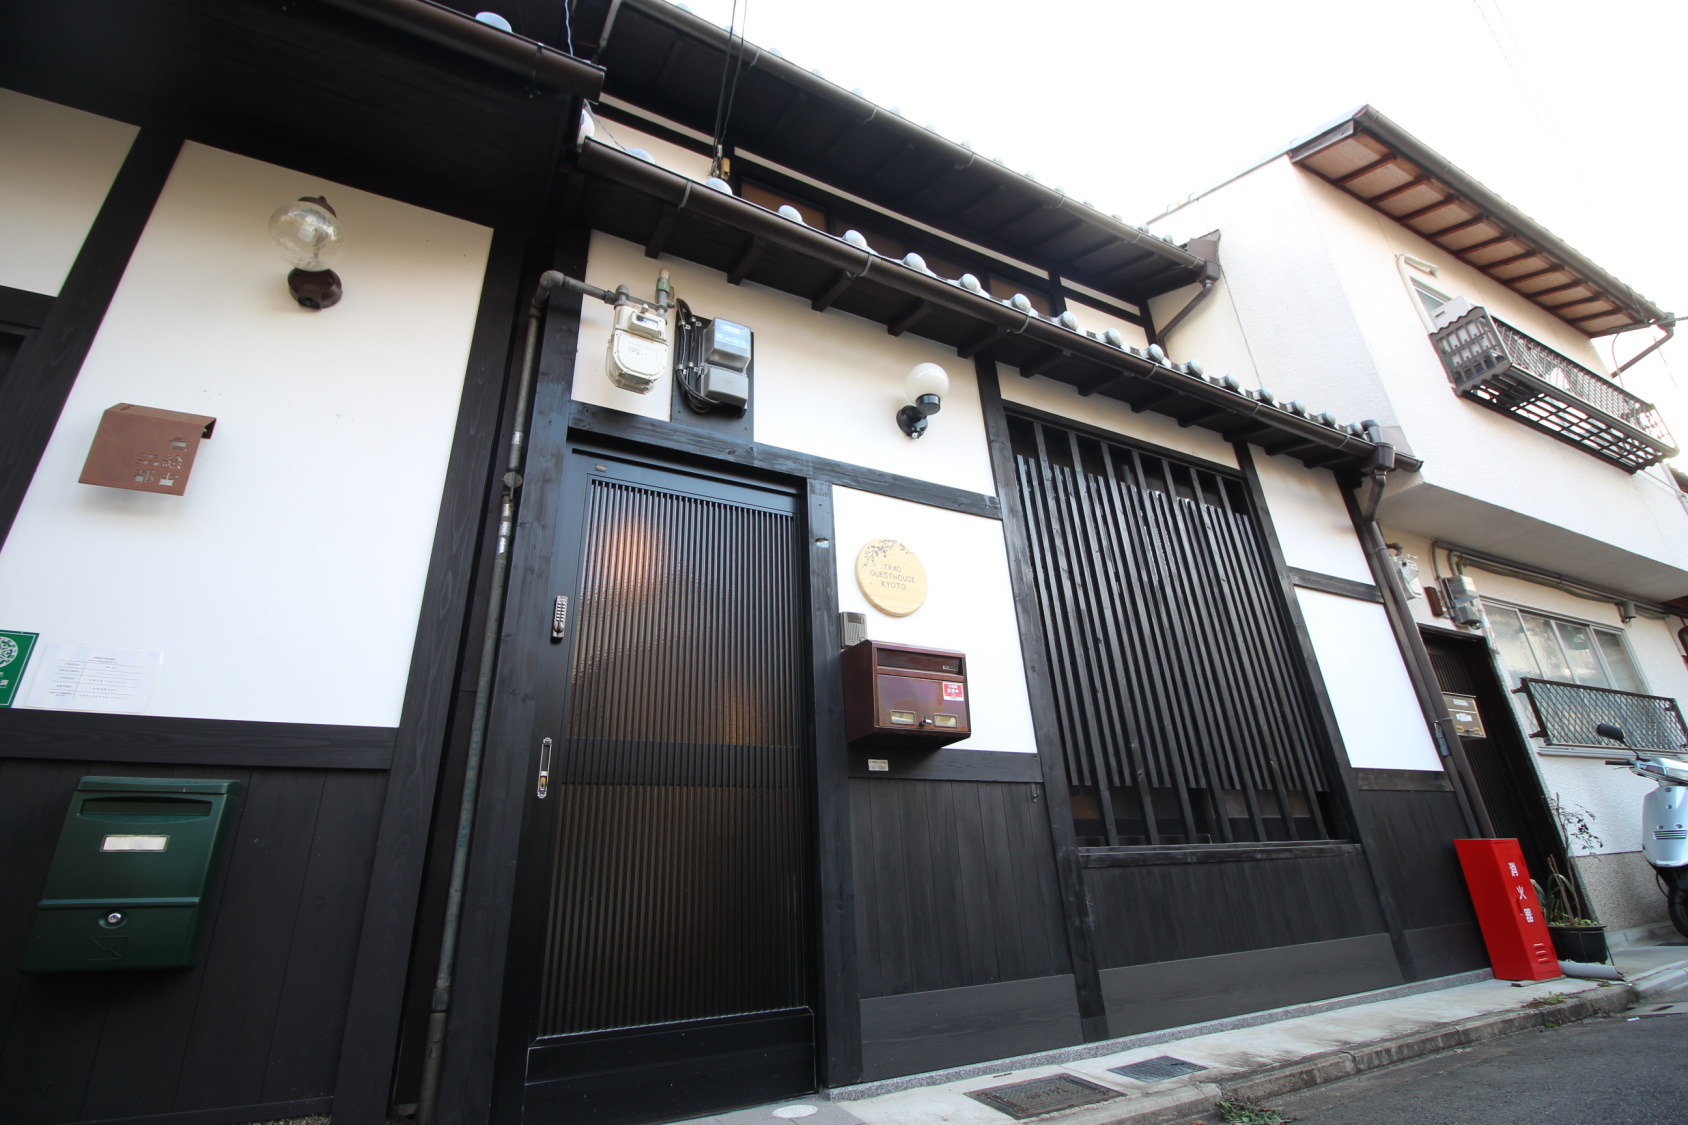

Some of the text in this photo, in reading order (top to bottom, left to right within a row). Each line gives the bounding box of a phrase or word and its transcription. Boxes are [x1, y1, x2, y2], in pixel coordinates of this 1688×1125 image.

[883, 563, 902, 573] TRAD
[870, 569, 916, 584] GUESTHOUSE
[881, 580, 907, 591] KYOTO
[1507, 862, 1535, 923] 消火器
